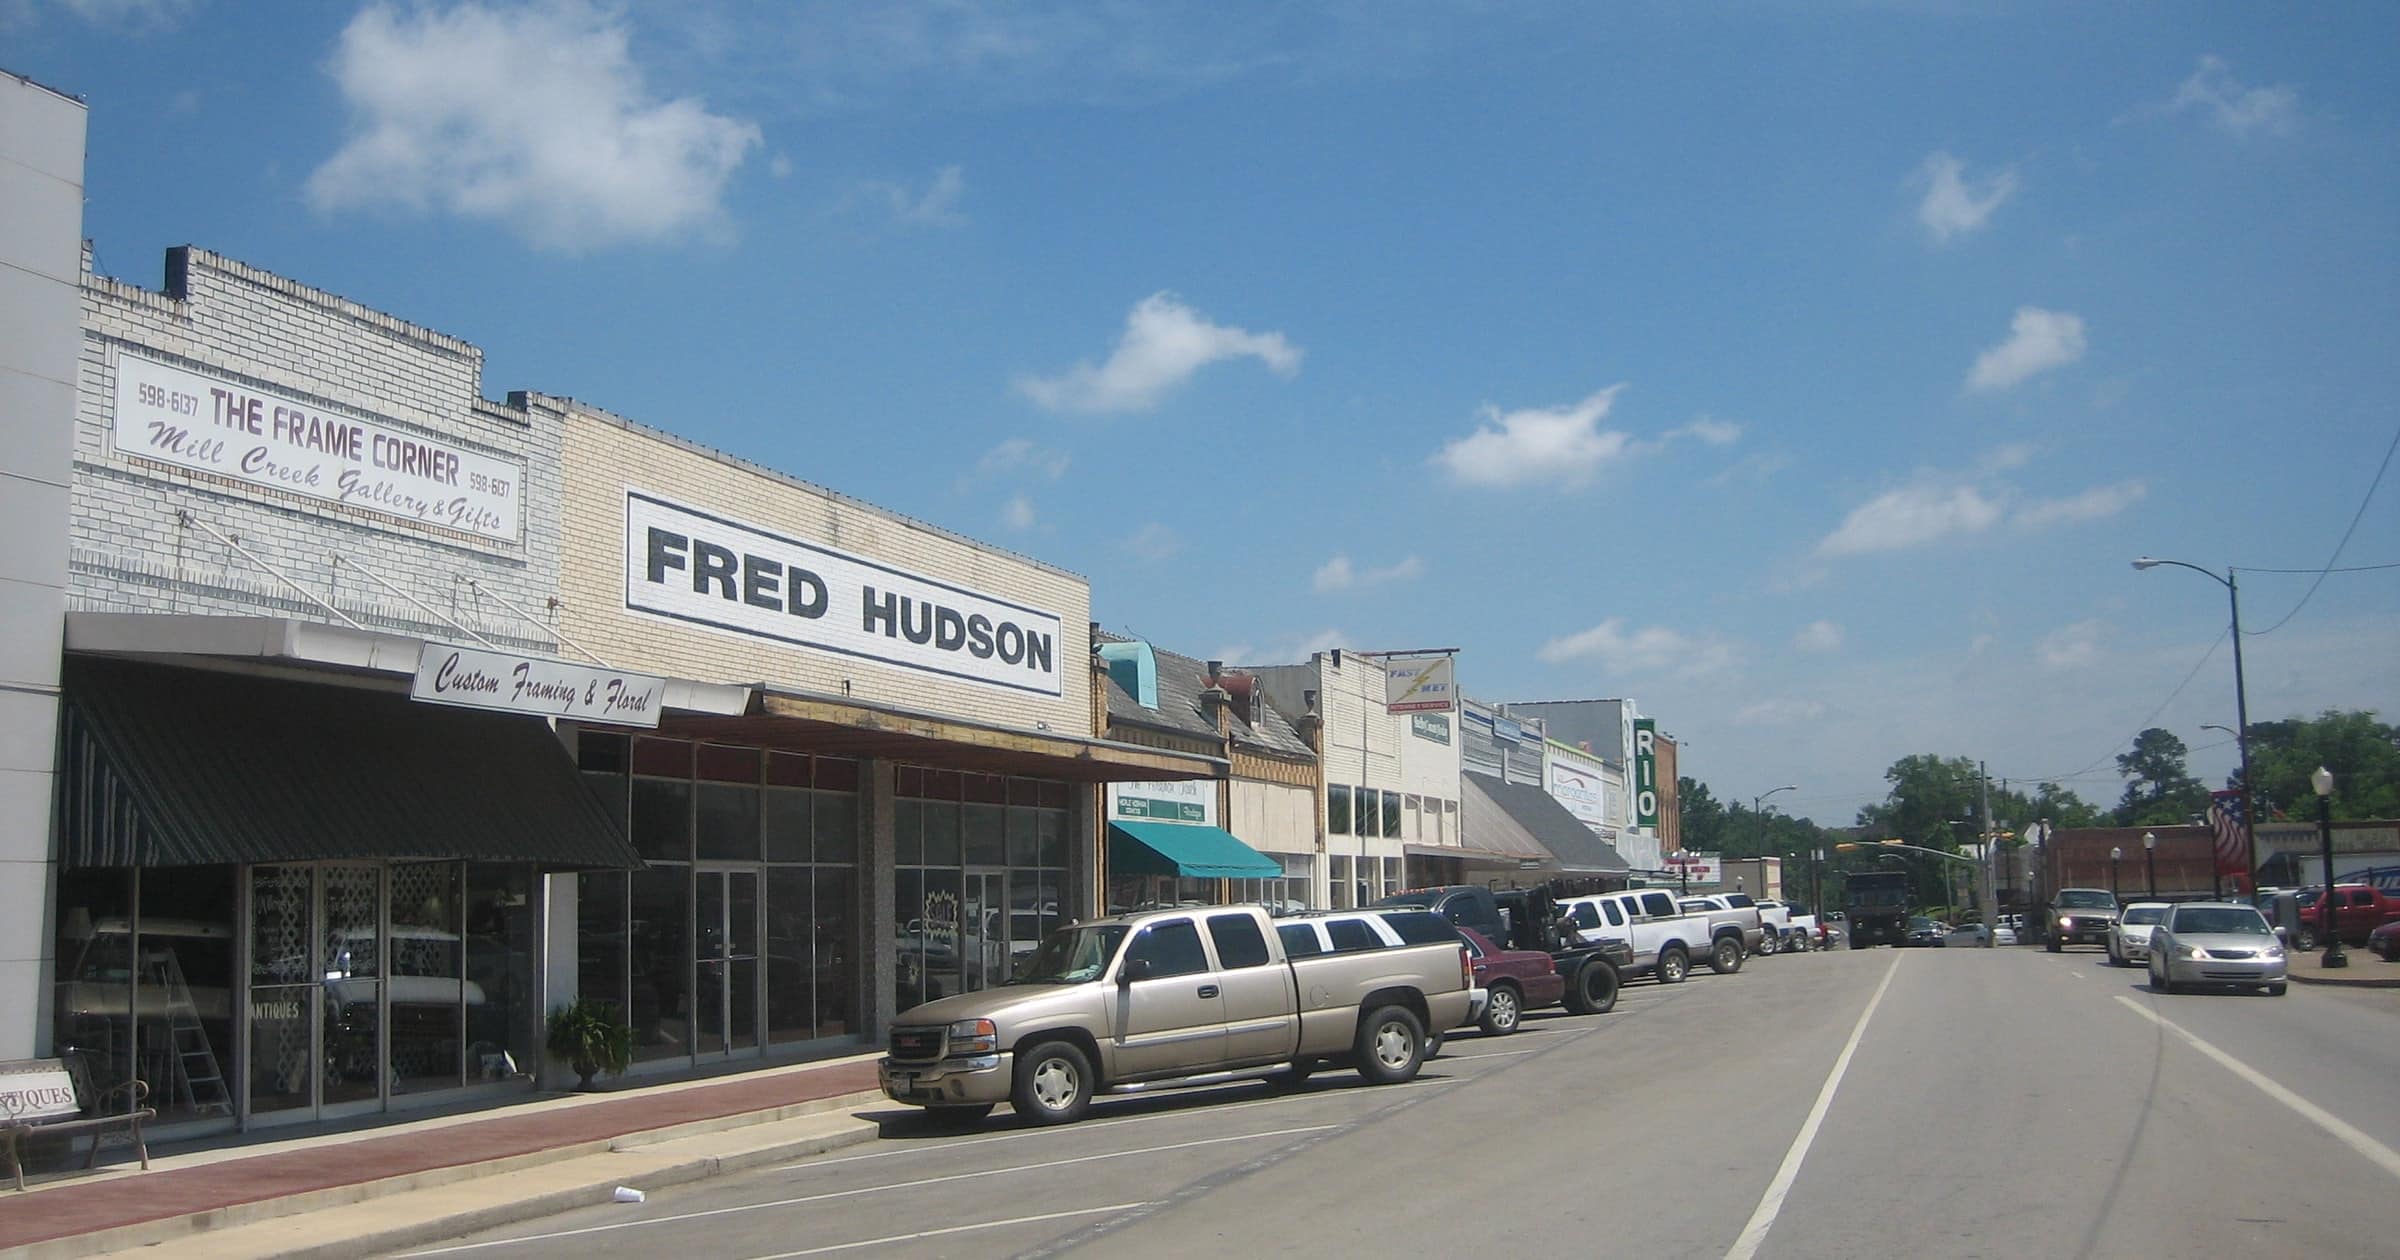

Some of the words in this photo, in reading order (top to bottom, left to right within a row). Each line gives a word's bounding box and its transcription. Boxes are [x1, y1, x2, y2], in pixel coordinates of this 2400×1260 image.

[138, 382, 199, 417] 598-6137
[210, 387, 264, 436] THE
[273, 406, 363, 463] FRAME
[373, 433, 460, 487] CORNER
[148, 420, 225, 464] Mill
[240, 446, 321, 488] Creek
[338, 469, 429, 520] Gallery
[432, 499, 444, 516] &
[448, 497, 501, 532] Gifts
[647, 526, 829, 620] FRED
[862, 584, 1053, 674] HUDSON
[434, 651, 501, 694] Custom
[512, 661, 577, 713] Framing
[584, 678, 598, 706] &
[603, 678, 652, 715] Floral
[1390, 668, 1421, 678] FAST
[1637, 729, 1657, 817] RIO
[248, 1001, 300, 1020] ANTIQUES
